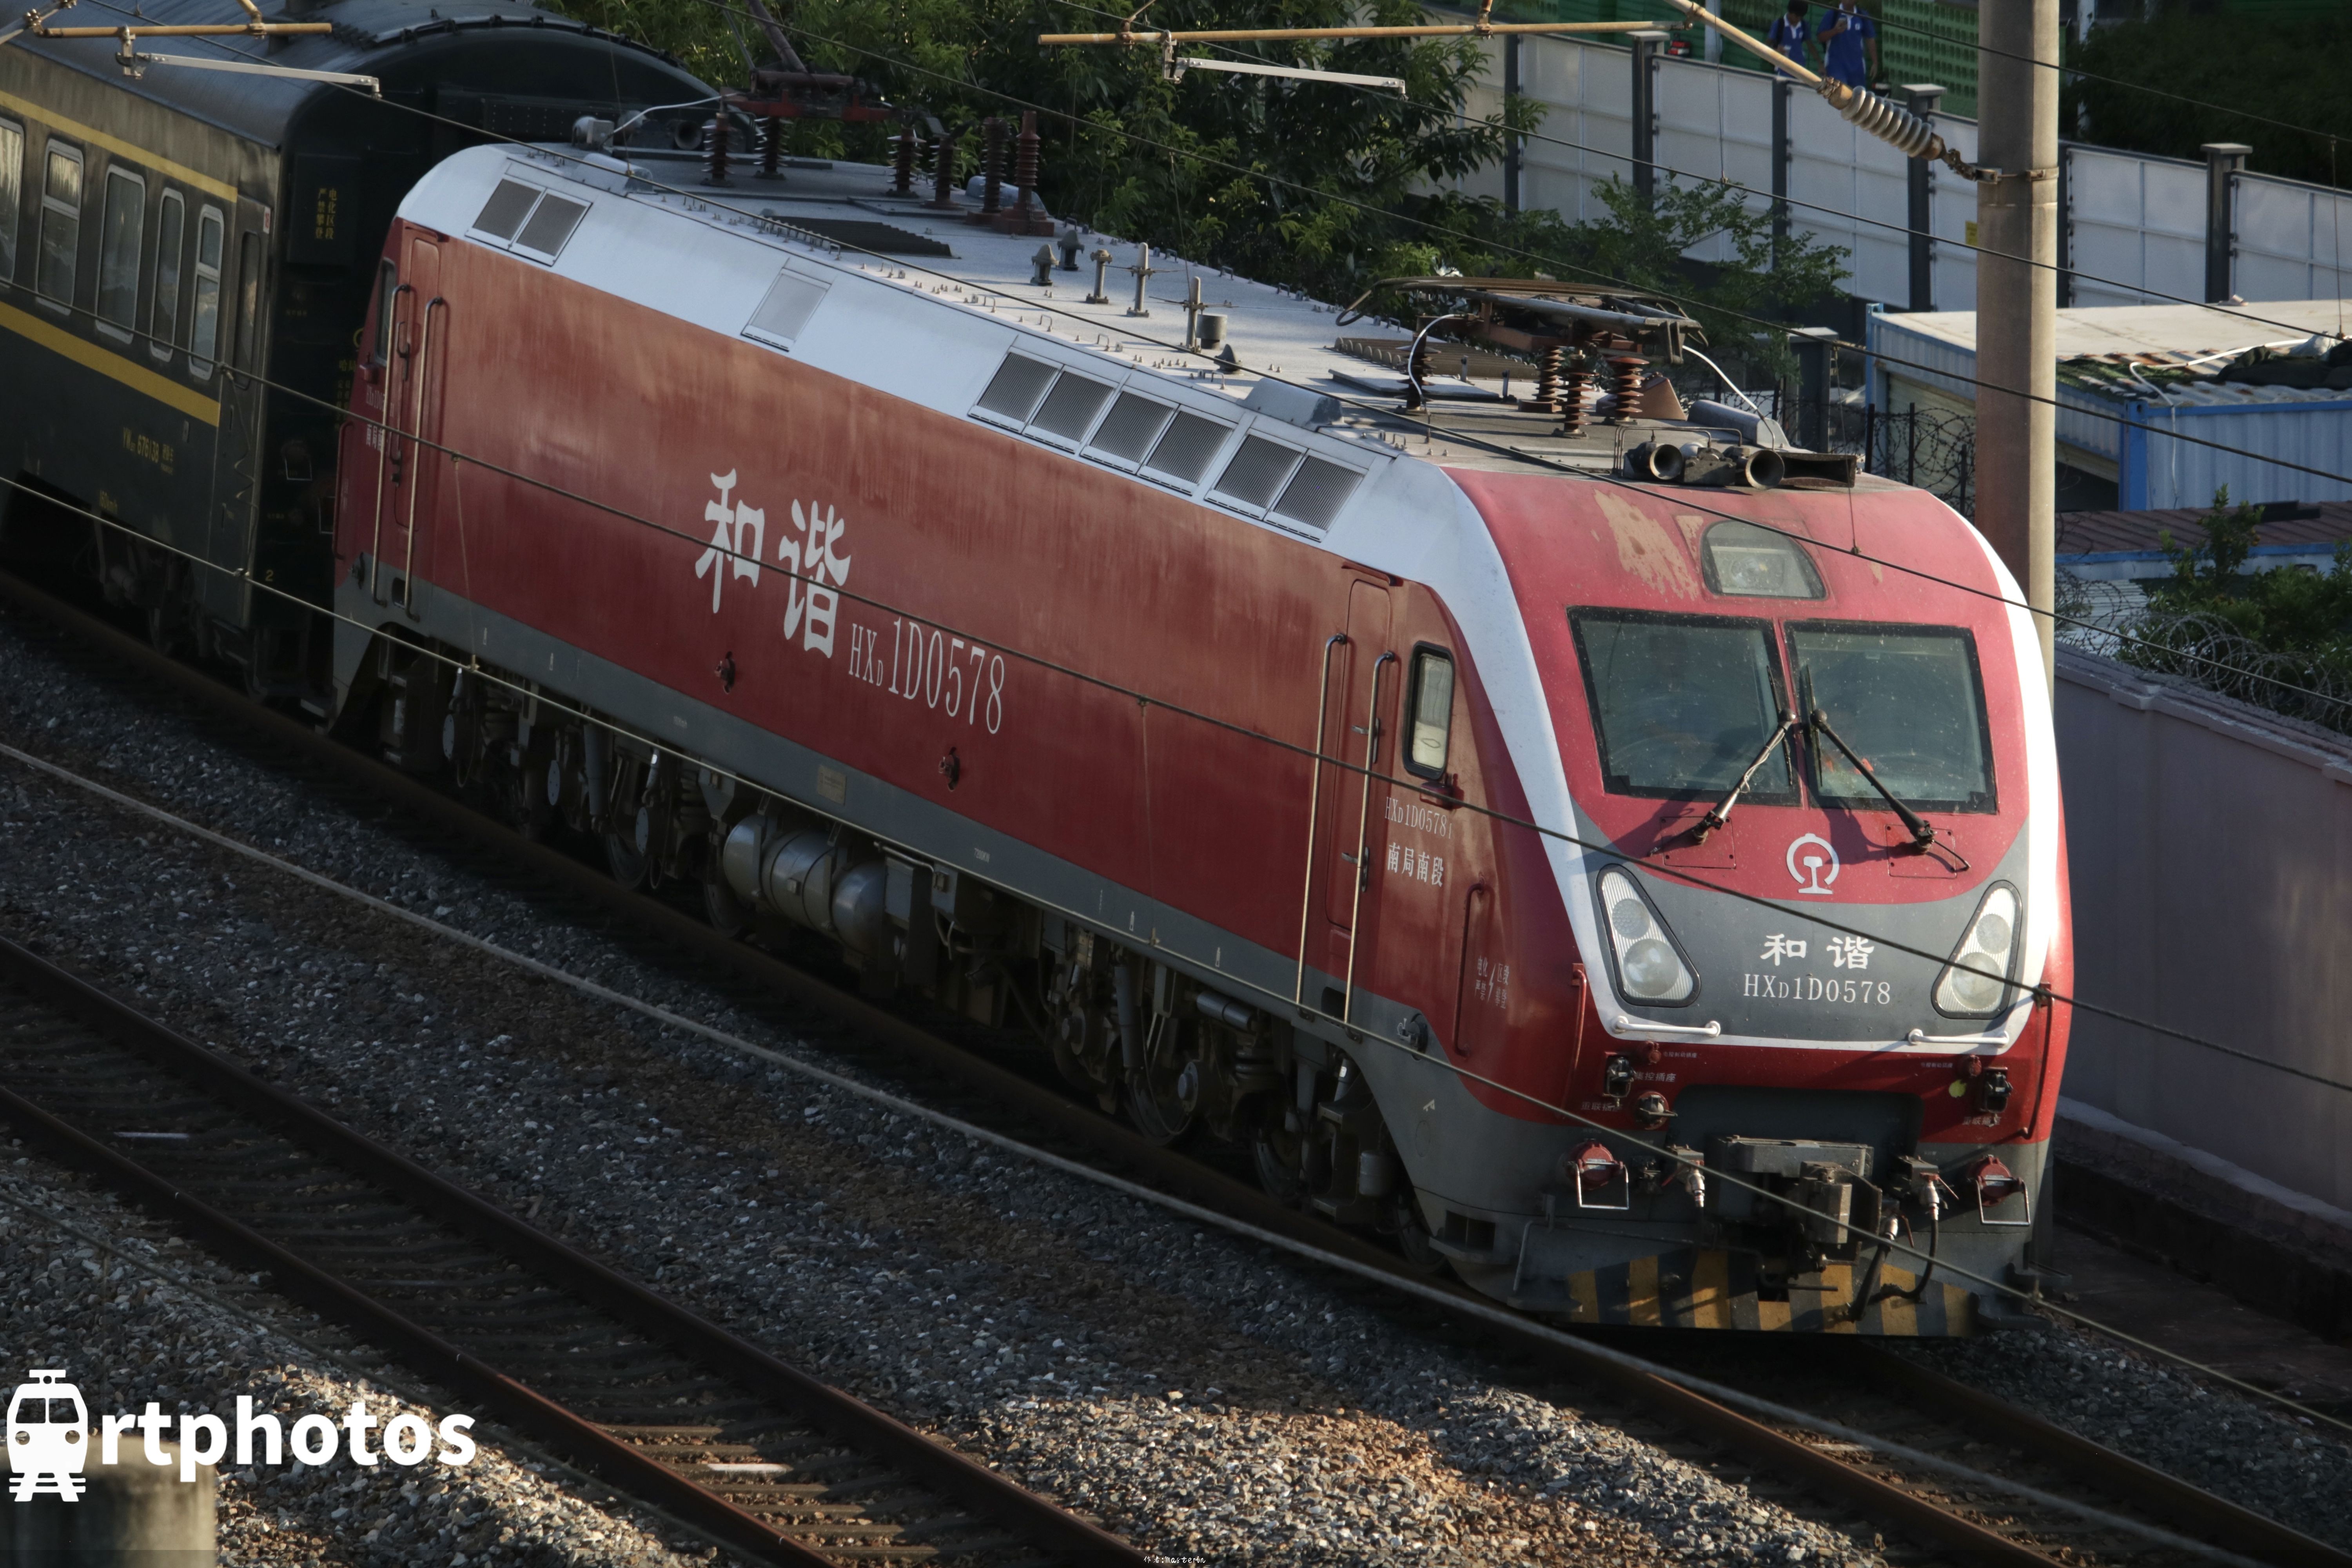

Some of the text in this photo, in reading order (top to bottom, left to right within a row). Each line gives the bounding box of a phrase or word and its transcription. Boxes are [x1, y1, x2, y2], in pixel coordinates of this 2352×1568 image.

[265, 570, 274, 581] 2
[695, 468, 851, 659] 和谐
[849, 616, 1005, 734] HXD1D0578
[1387, 842, 1444, 887] 南局南段
[1760, 934, 1874, 969] 和谐
[1743, 974, 1890, 1004] HXD1D0578
[1634, 1072, 1677, 1083] 集控插座
